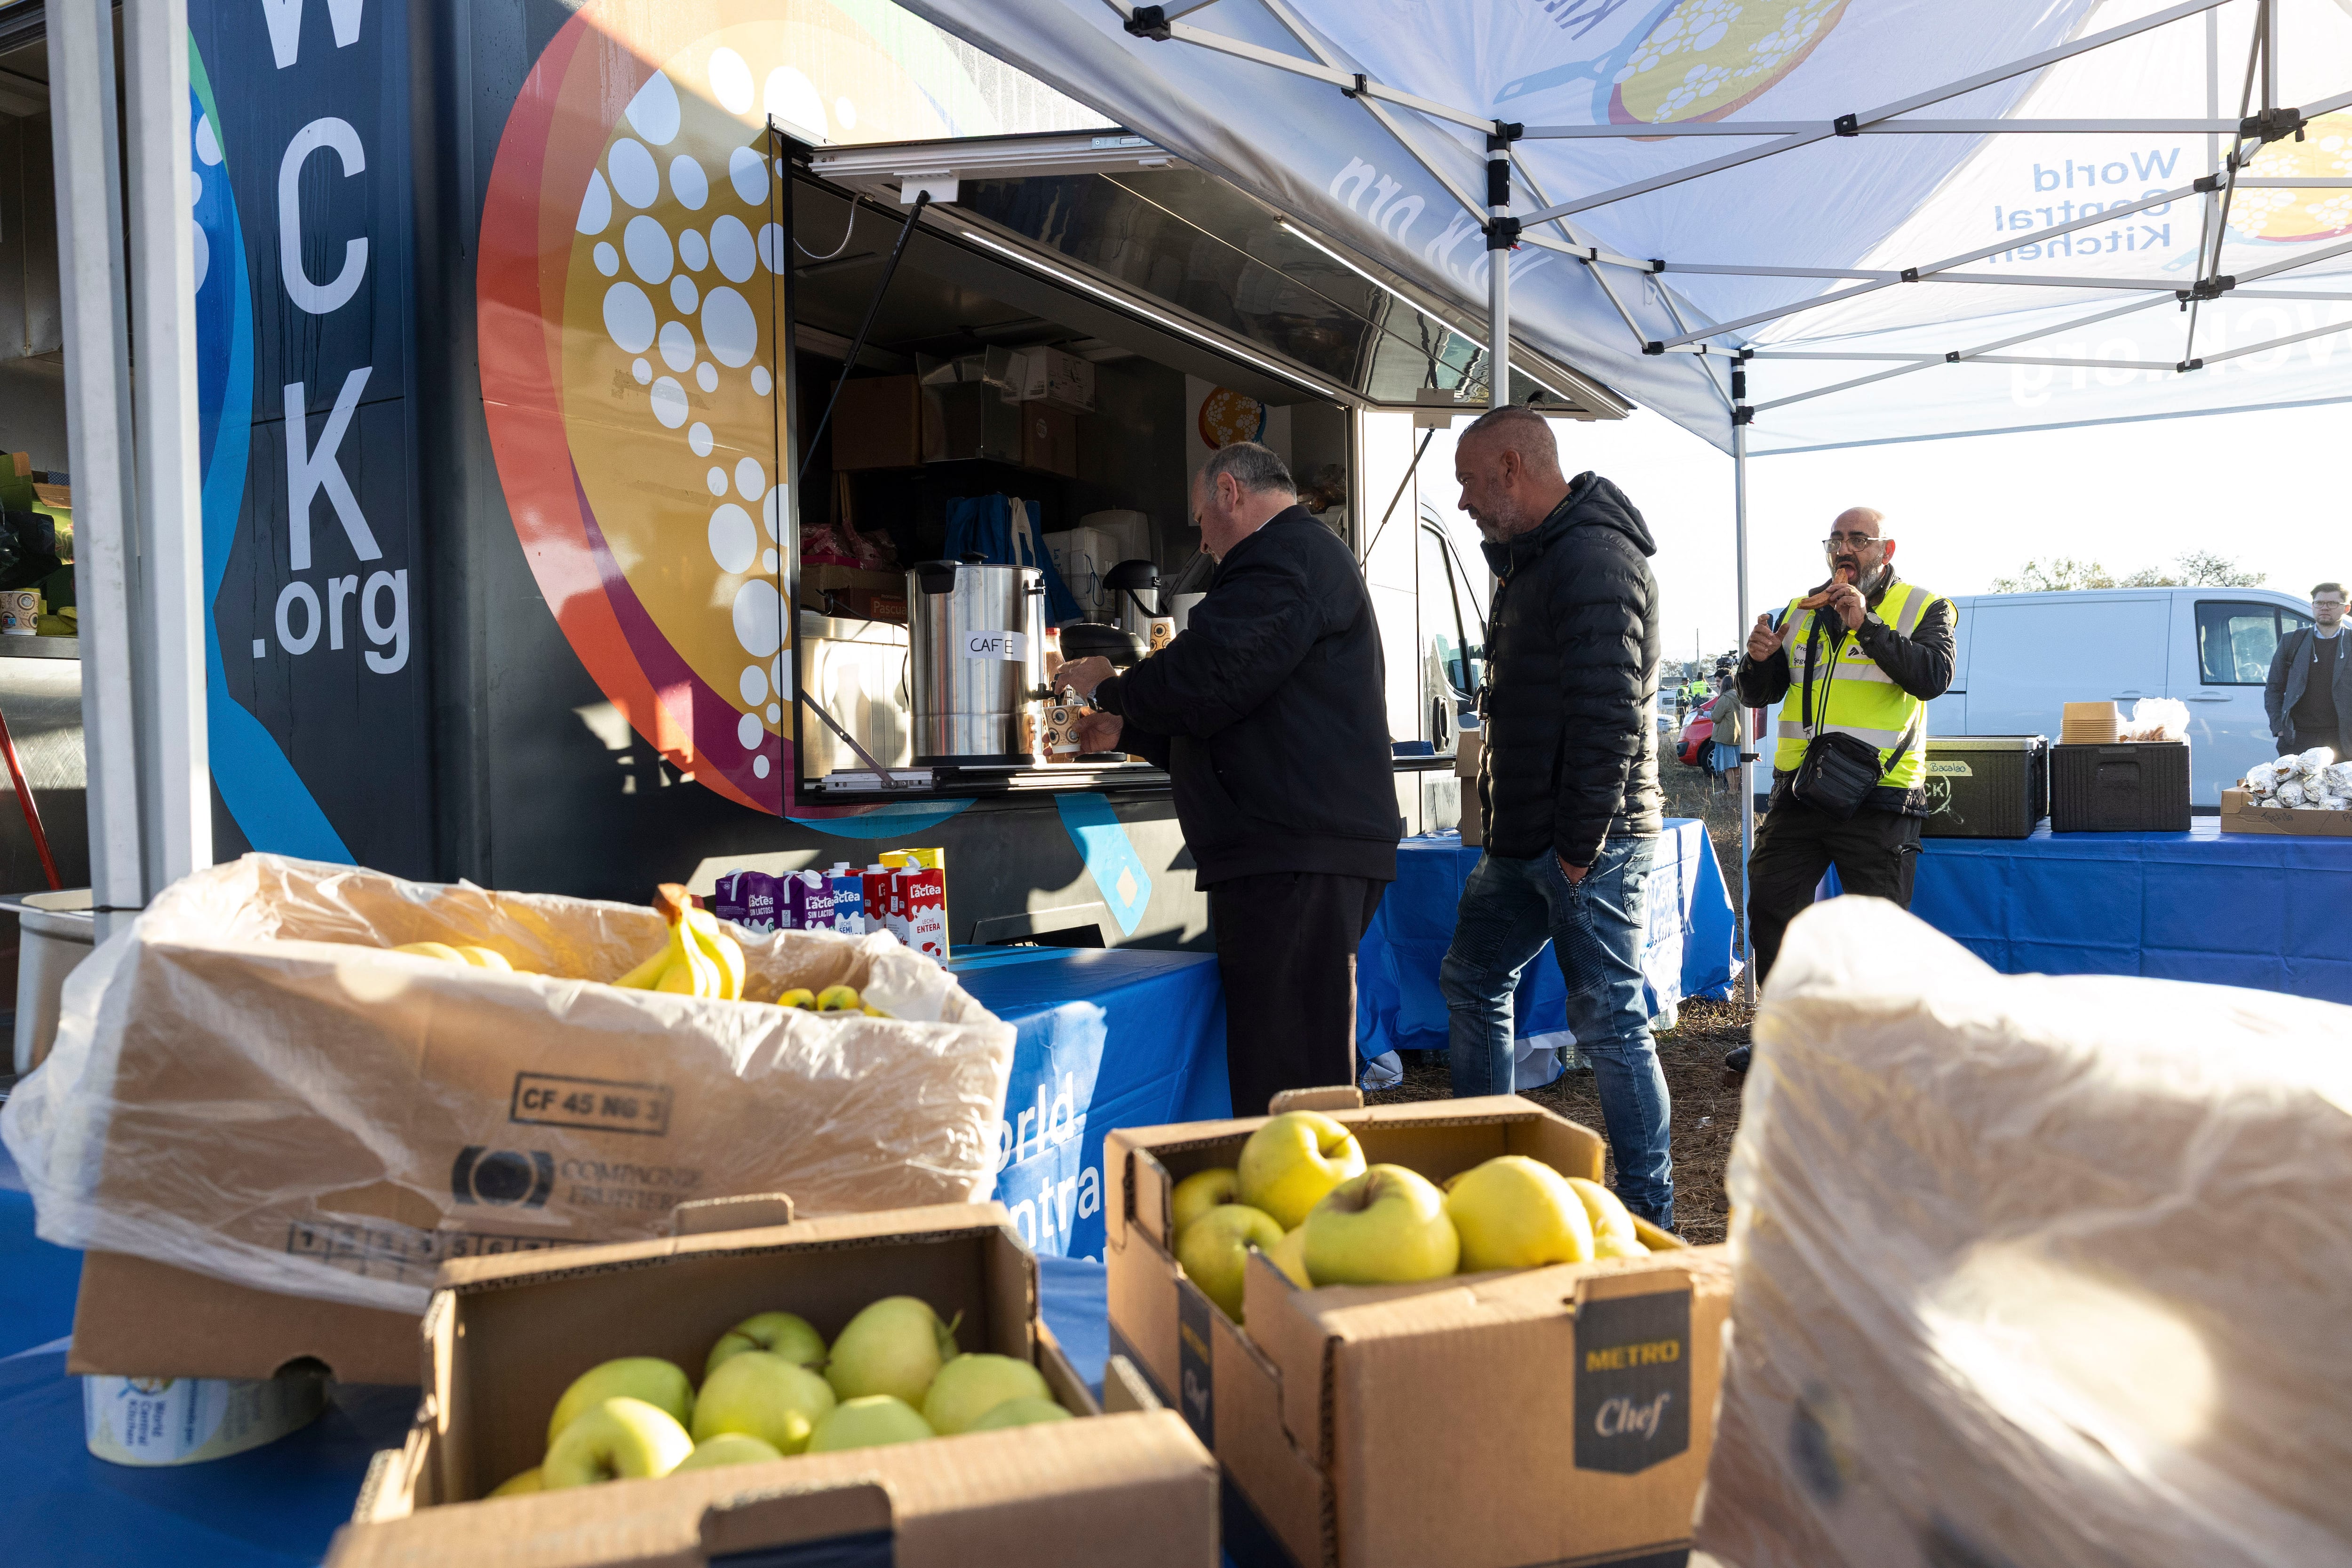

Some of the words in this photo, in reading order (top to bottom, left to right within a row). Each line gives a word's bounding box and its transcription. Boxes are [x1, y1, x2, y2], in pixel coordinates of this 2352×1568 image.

[253, 569, 410, 674] .org
[970, 638, 1013, 654] CAFE
[1930, 763, 1966, 772] Bacalao
[1924, 782, 1945, 797] CK
[834, 889, 860, 904] áctea
[910, 883, 941, 899] Láctea
[806, 895, 834, 909] Láctea
[755, 907, 774, 915] LACTOSA
[917, 923, 941, 933] ENTERA
[522, 1088, 557, 1111] CF
[562, 1092, 594, 1115] 45
[996, 1071, 1074, 1174] orld
[1009, 1142, 1107, 1249] ntra
[1586, 1340, 1680, 1372] METRO
[1595, 1392, 1671, 1440] Chef
